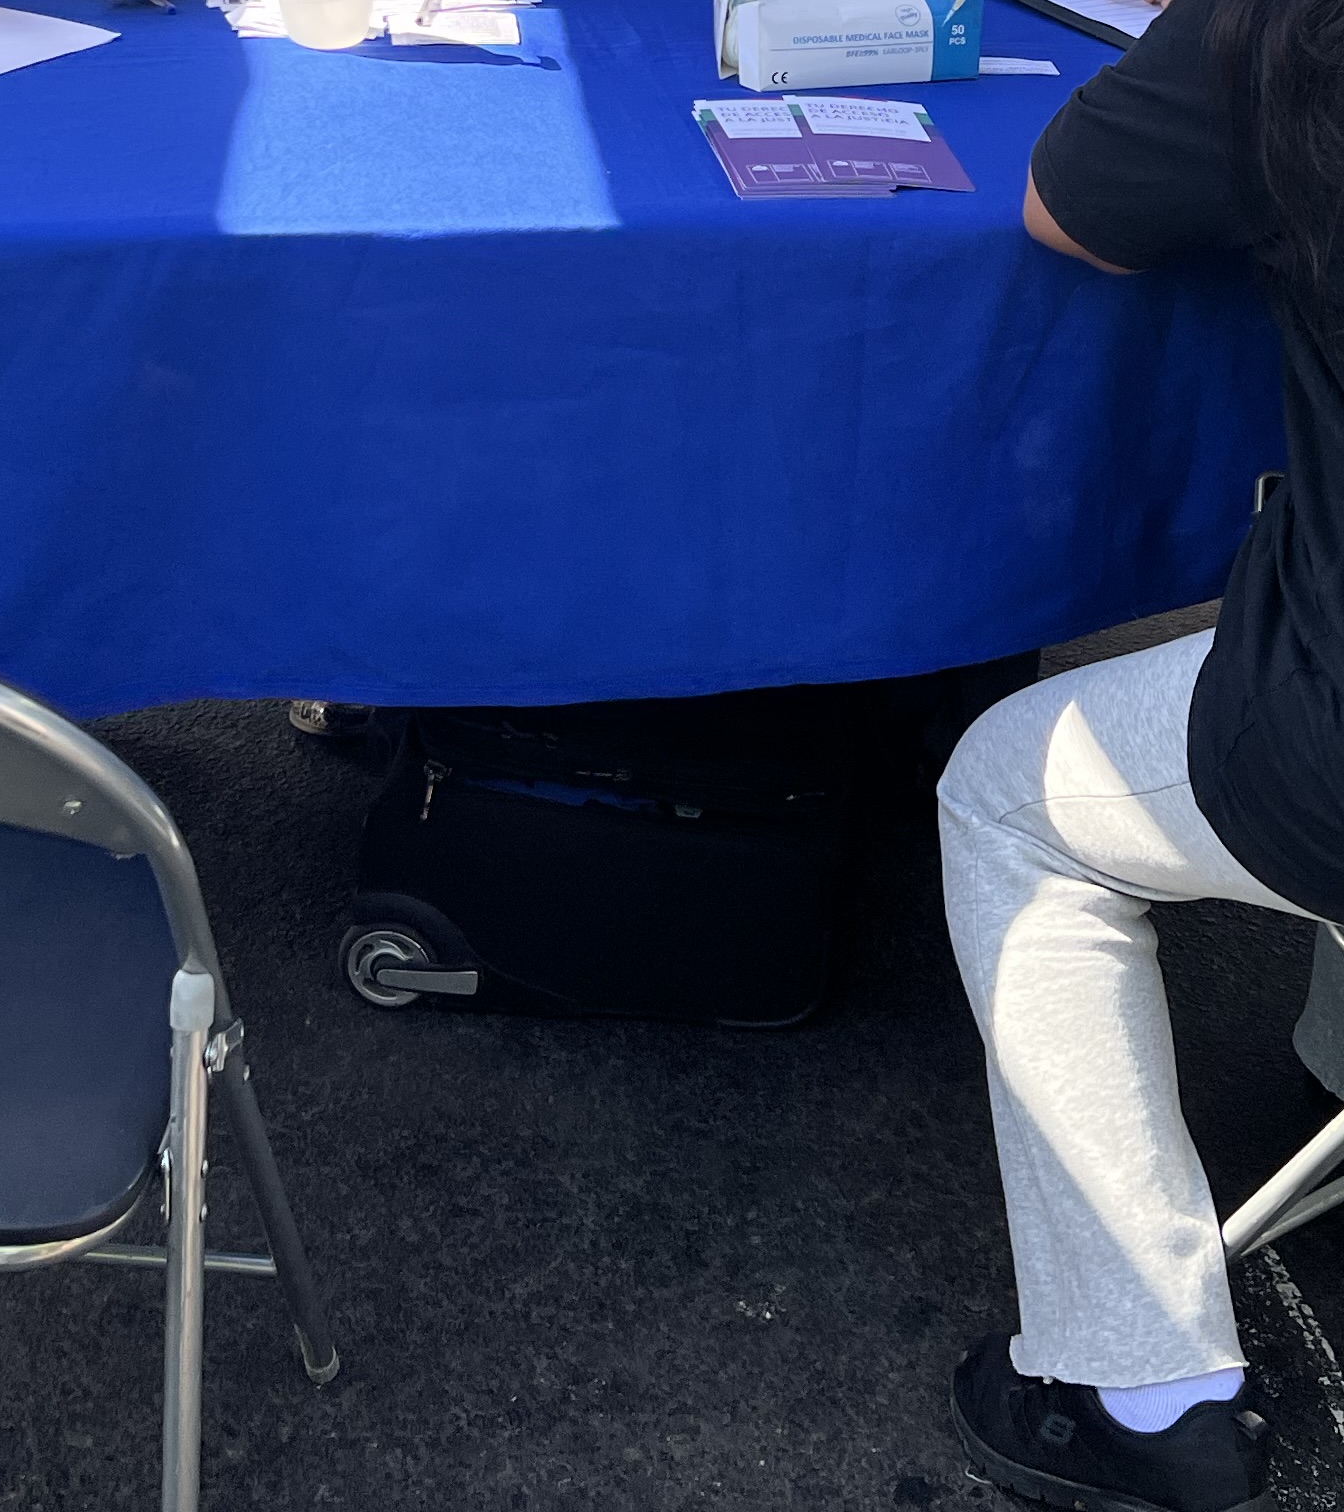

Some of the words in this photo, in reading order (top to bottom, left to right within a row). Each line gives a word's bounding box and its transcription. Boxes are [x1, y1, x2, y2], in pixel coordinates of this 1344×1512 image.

[951, 24, 965, 35] 50
[792, 35, 844, 45] DISPOSABLE
[845, 33, 882, 43] MEDICAL
[883, 31, 903, 40] FACE
[905, 29, 929, 39] MASK
[949, 36, 966, 45] PCS
[771, 71, 789, 84] CE
[829, 104, 899, 114] DERECHO
[832, 109, 890, 117] ACCESO
[847, 115, 909, 125] JUSTICIA
